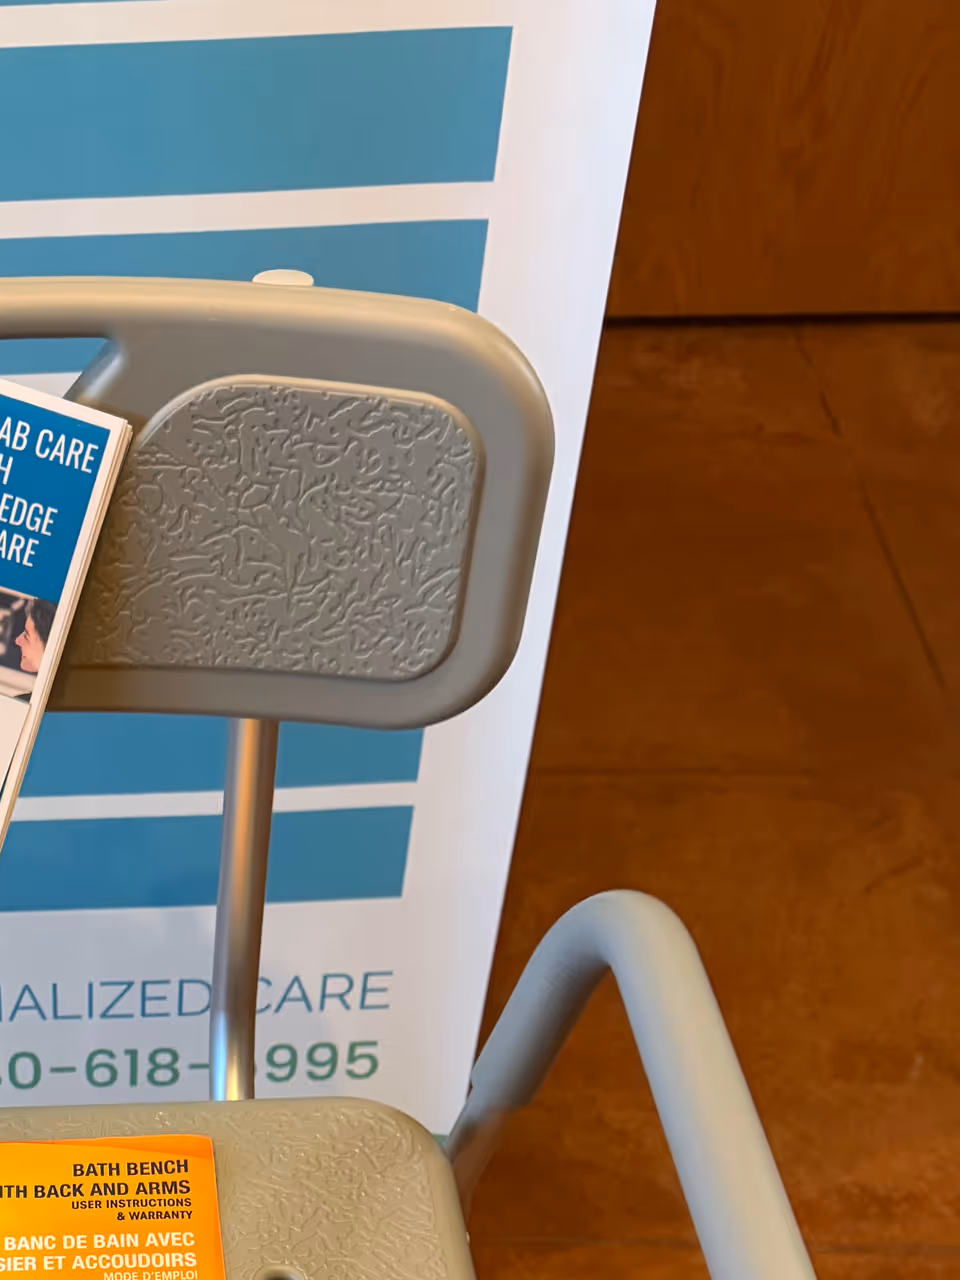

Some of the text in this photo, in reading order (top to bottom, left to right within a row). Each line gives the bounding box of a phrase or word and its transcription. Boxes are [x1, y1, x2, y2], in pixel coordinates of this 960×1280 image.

[34, 428, 99, 473] CARE
[73, 1159, 189, 1177] BATH BENCH
[34, 1183, 84, 1199] BACK
[90, 1182, 129, 1197] AND
[135, 1180, 191, 1195] ARMS
[71, 1198, 192, 1210] USER INSTRUCTIONS
[117, 1210, 193, 1221] & WARRANTY
[4, 1231, 195, 1251] BANC DE BAIN AVEC
[43, 1255, 66, 1270] ET
[72, 1252, 197, 1270] ACCOUDOIRS
[143, 1270, 198, 1280] D'EMPLOI
